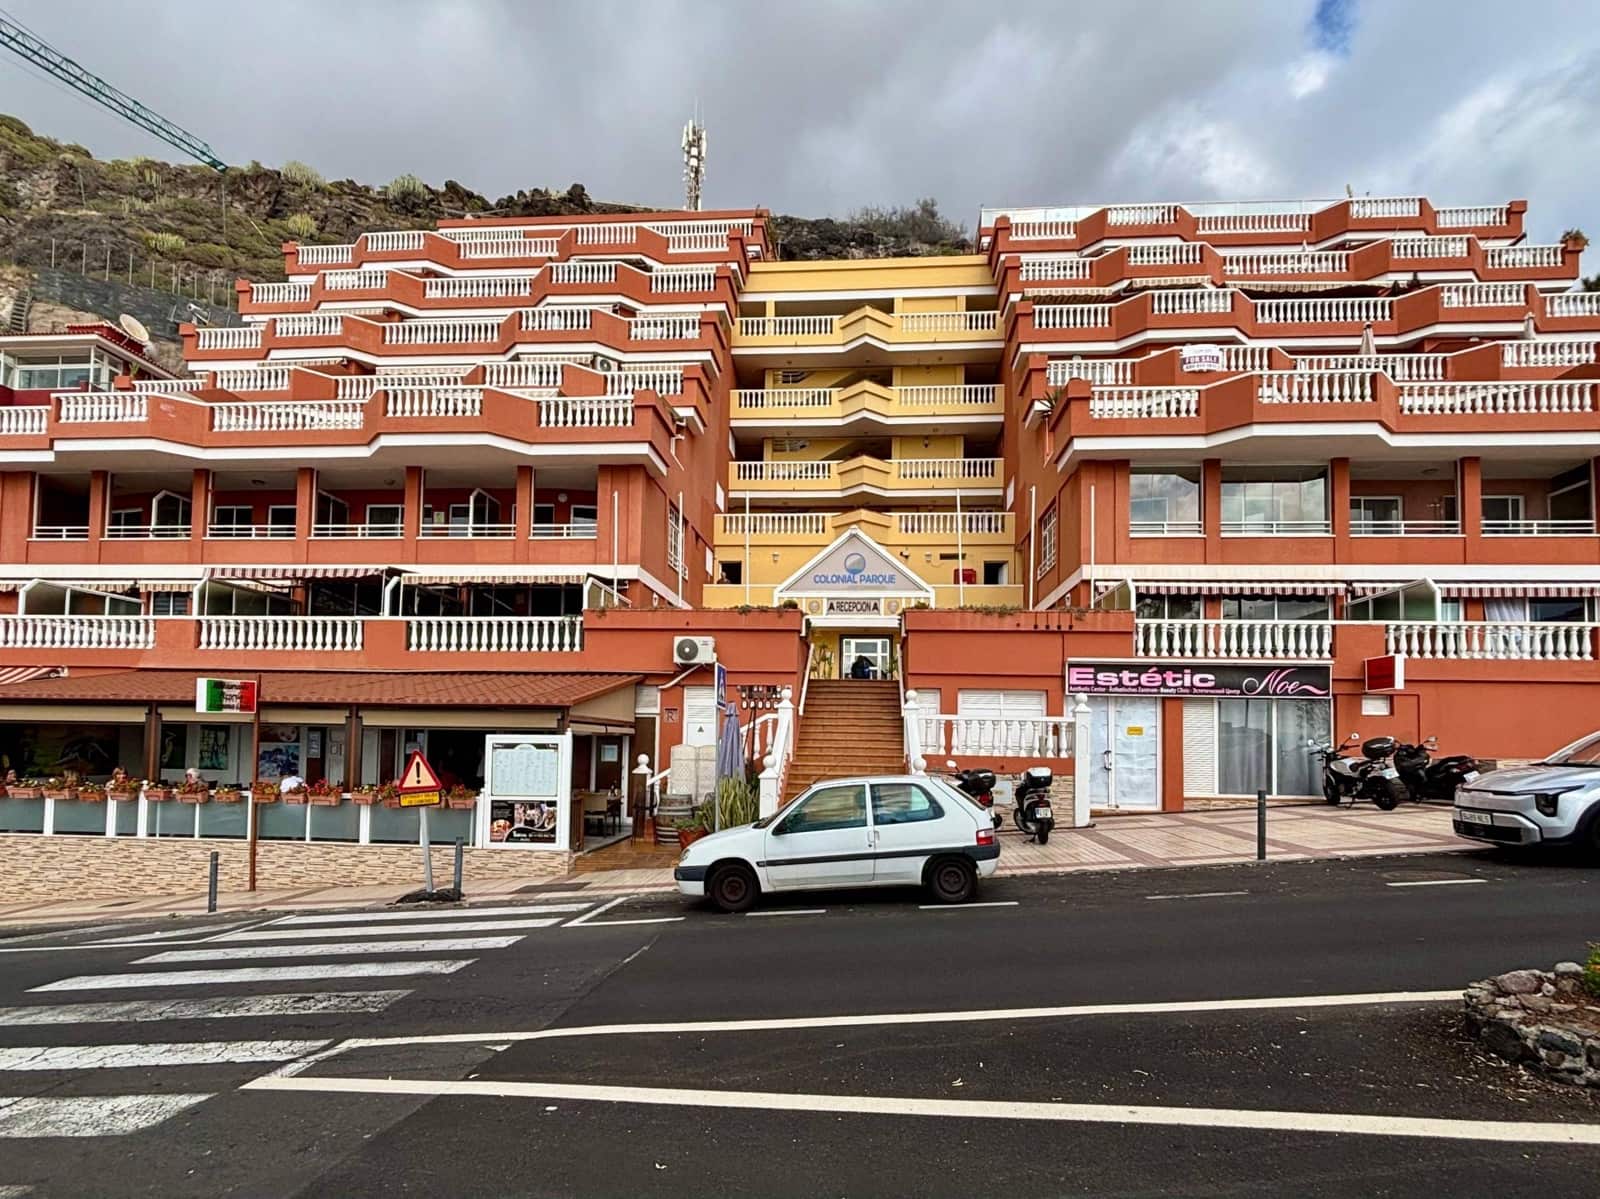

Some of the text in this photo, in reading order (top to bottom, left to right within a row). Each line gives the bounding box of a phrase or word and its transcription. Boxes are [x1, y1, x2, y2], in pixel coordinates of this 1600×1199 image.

[813, 574, 896, 584] COLONIAL PARQUE
[1069, 666, 1216, 687] Estétic
[1242, 668, 1329, 695] Noe
